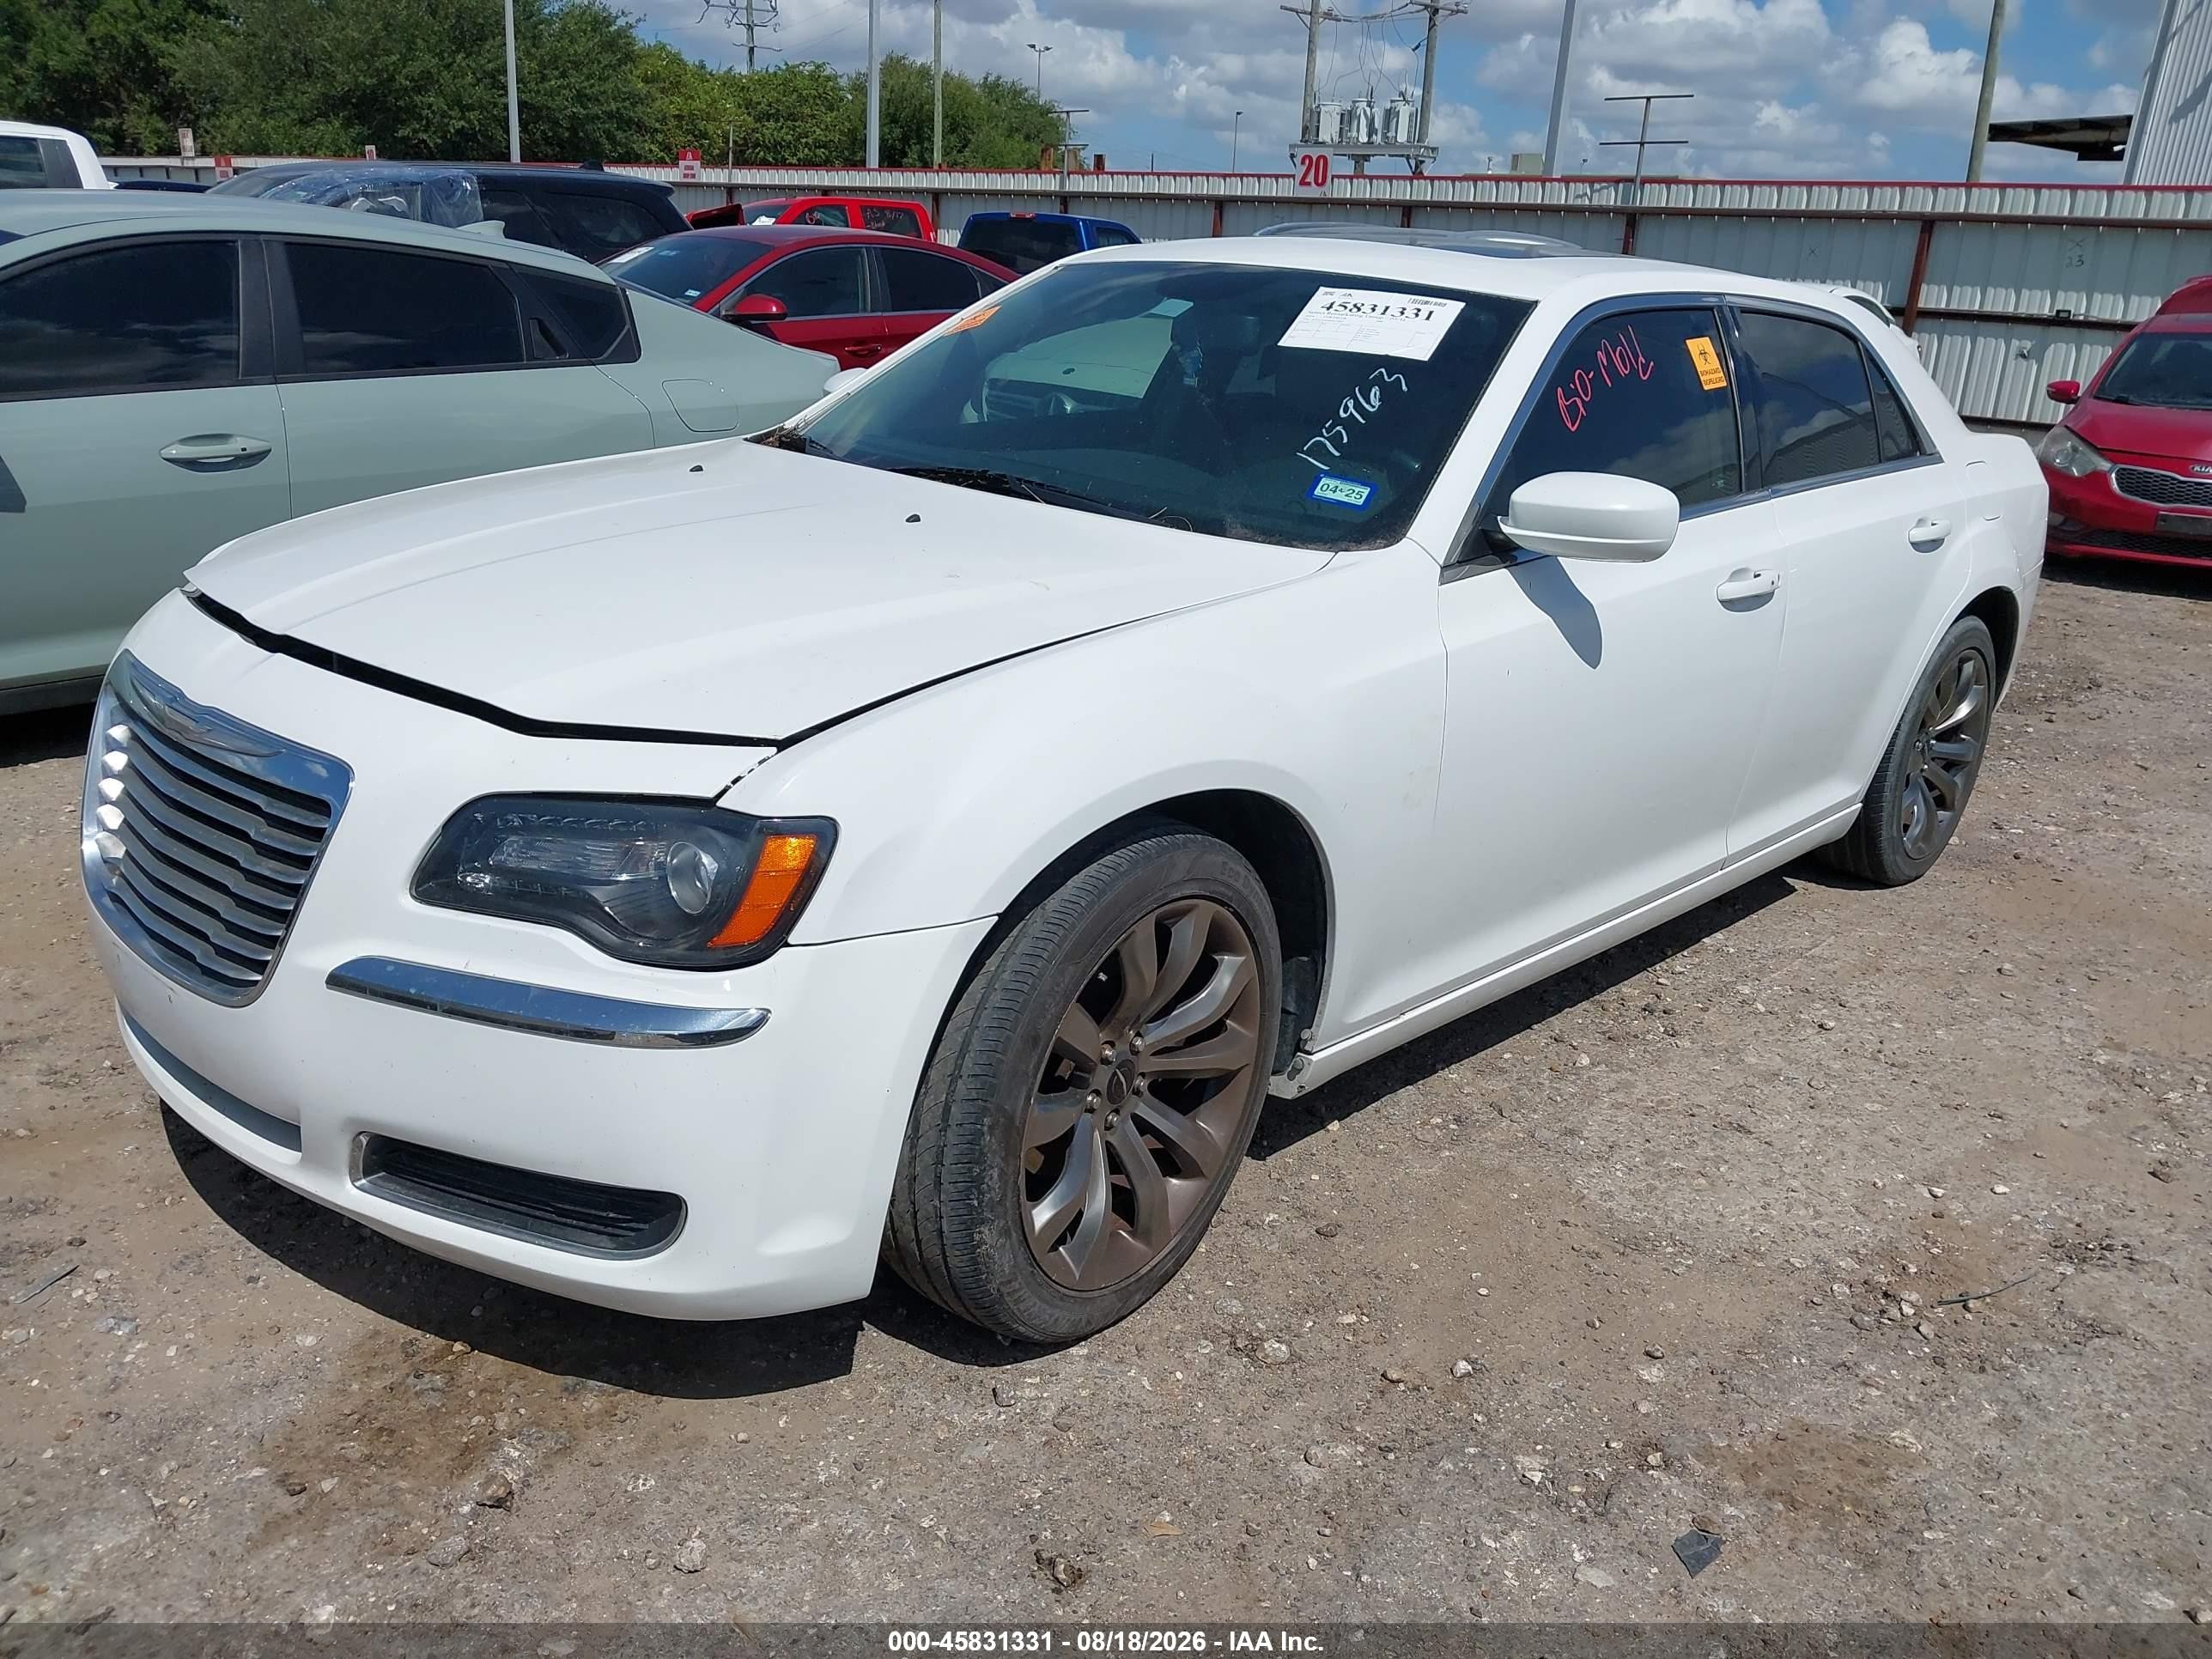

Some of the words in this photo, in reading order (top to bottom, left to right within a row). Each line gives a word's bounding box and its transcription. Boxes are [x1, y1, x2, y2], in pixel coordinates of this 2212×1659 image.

[1298, 154, 1328, 187] 20
[1321, 301, 1434, 321] 45831331
[1296, 367, 1408, 470] 175963
